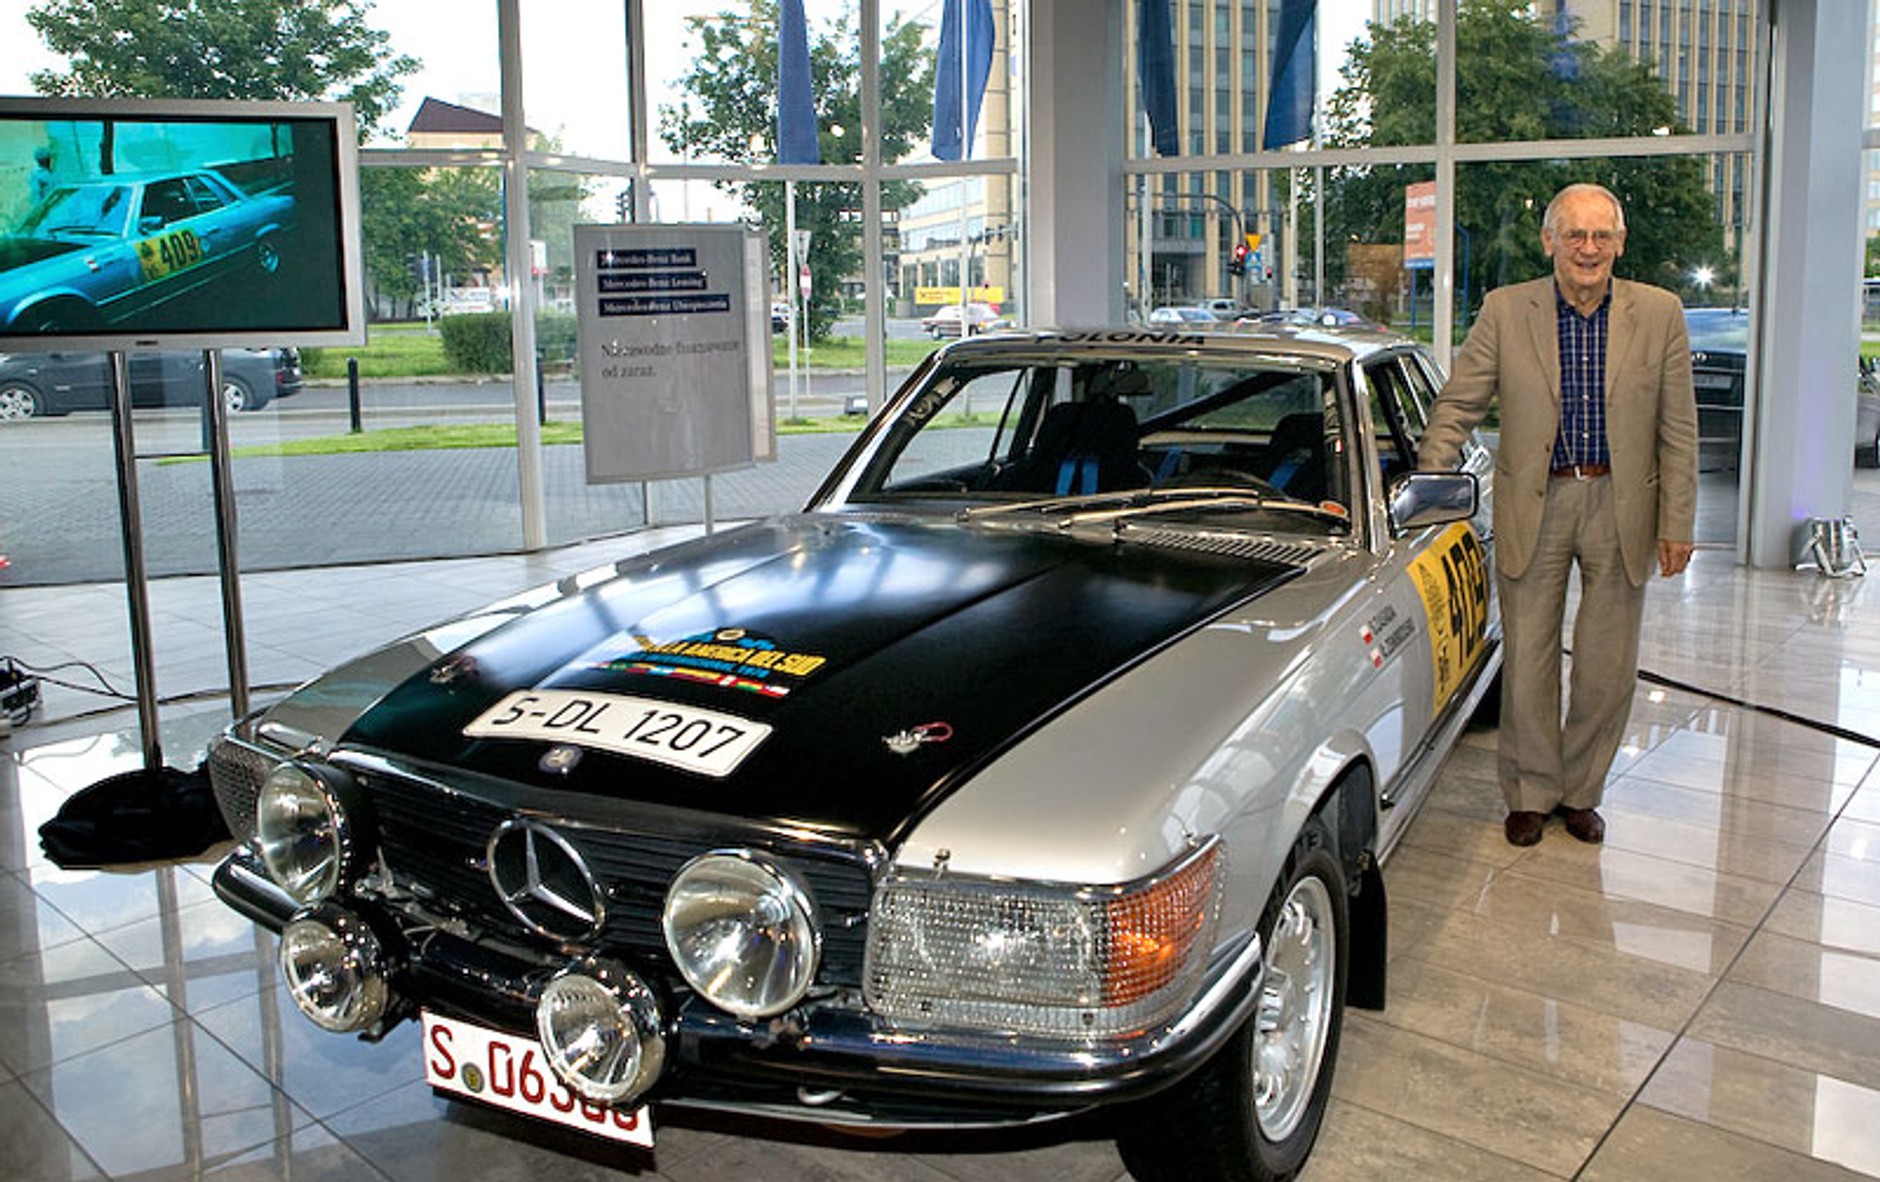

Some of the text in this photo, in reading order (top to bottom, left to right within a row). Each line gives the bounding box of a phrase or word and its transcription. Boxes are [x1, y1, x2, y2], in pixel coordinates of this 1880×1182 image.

[491, 697, 747, 758] S-DL 1207
[430, 1023, 457, 1080] S
